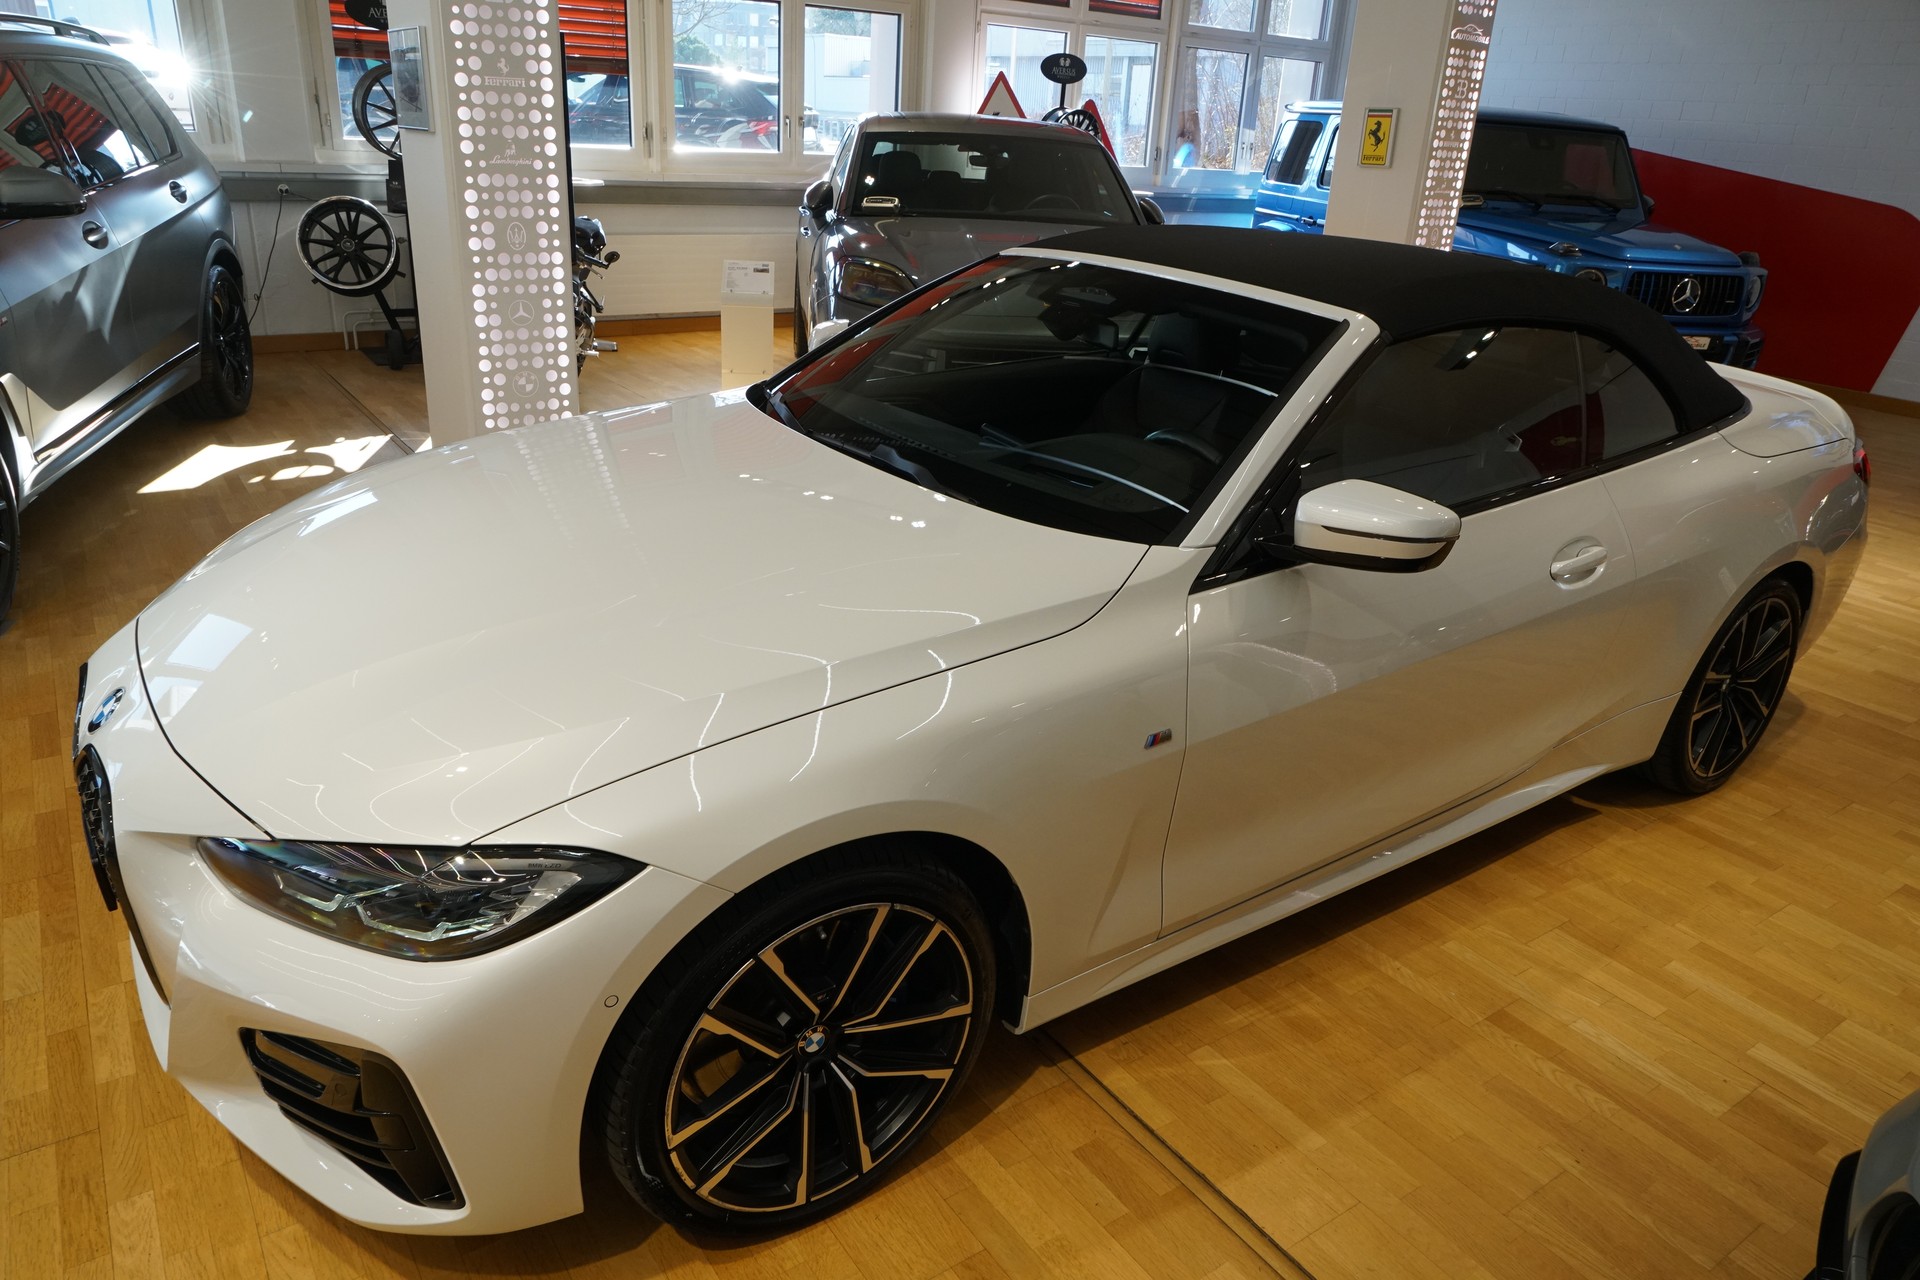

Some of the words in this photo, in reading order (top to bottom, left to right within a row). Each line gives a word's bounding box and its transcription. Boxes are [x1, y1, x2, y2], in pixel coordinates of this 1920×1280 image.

[1456, 33, 1490, 44] AUTOMOBILE
[1051, 66, 1076, 77] AVERSUS
[484, 76, 526, 88] Ferrari
[1362, 154, 1385, 162] Ferrari
[799, 1026, 824, 1047] BMW
